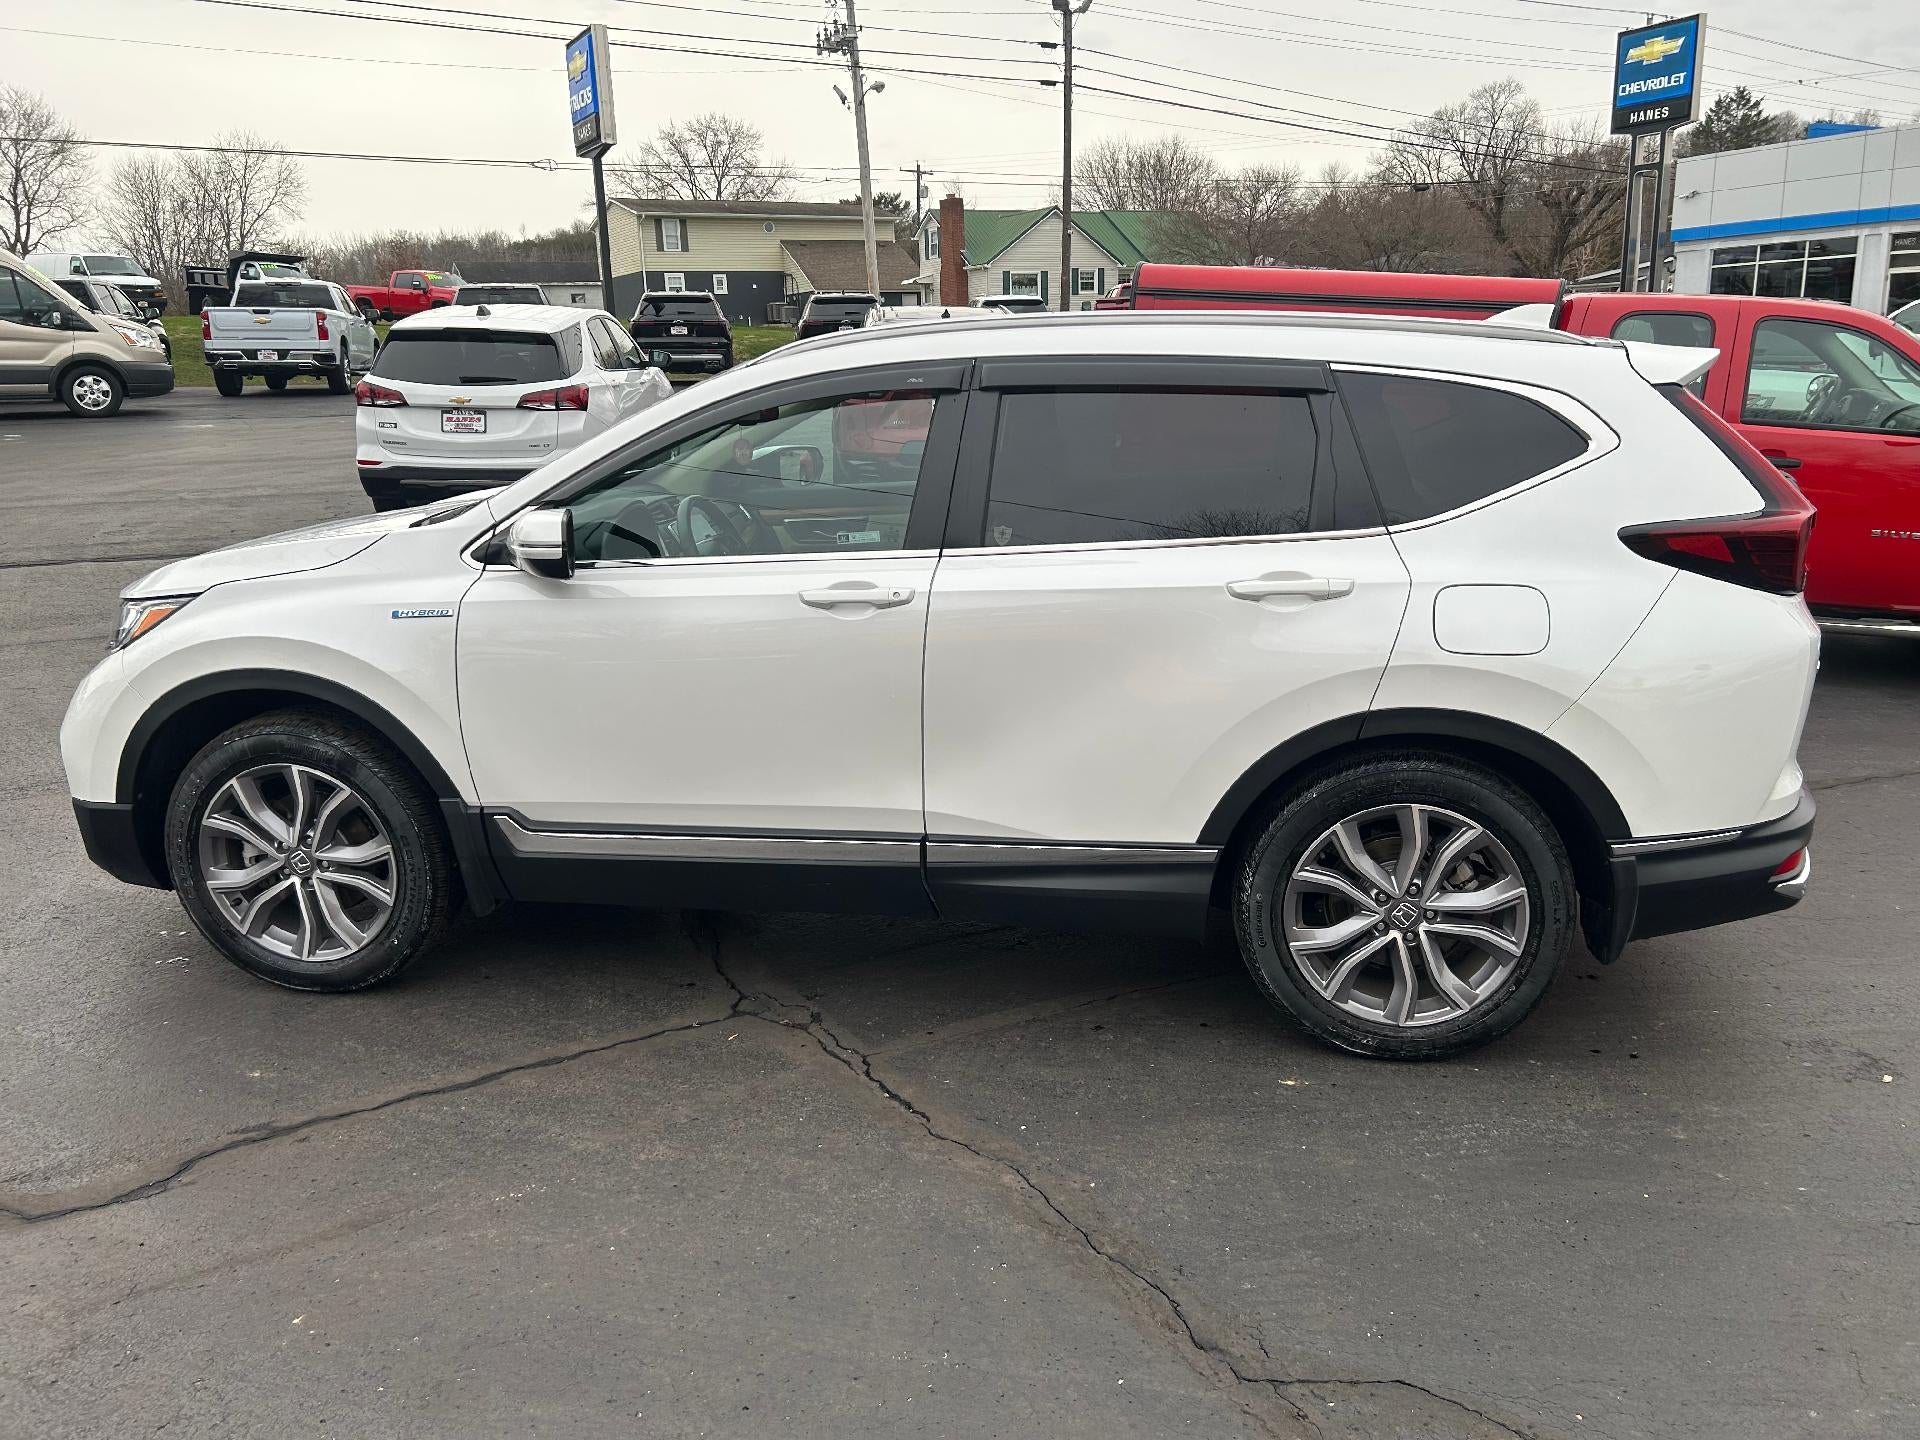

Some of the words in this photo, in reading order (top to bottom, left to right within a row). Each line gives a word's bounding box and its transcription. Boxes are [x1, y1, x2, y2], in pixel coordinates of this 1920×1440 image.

[1618, 72, 1687, 96] CHEVROLET
[1630, 106, 1669, 123] HANES
[400, 609, 450, 617] HYBRID
